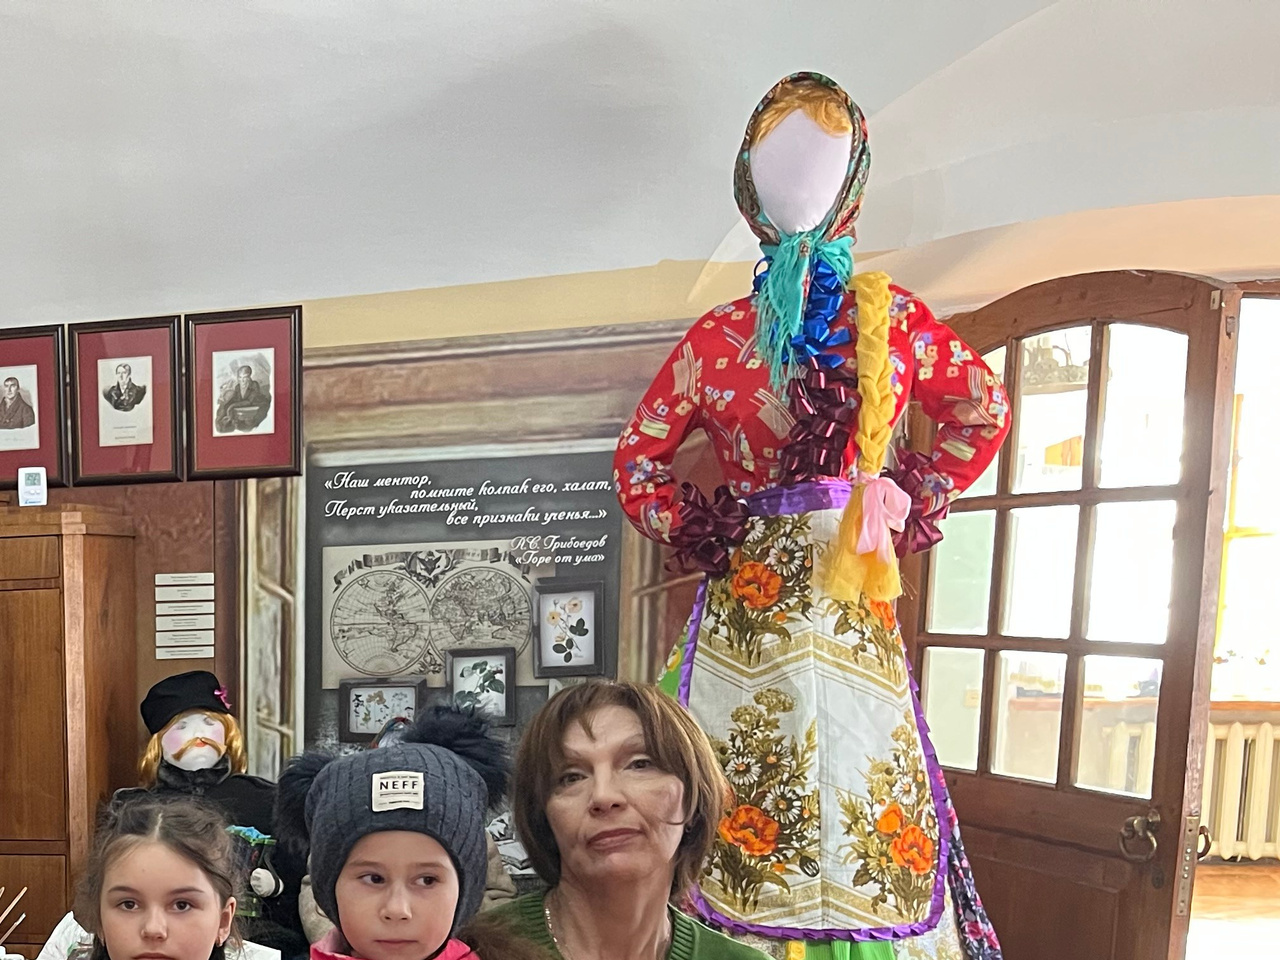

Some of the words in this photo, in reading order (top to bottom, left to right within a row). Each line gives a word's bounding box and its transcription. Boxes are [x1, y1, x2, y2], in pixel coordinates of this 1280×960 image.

[324, 471, 369, 489] «Наш
[373, 475, 432, 488] ментор,
[410, 487, 475, 499] помните
[478, 478, 532, 496] колпак
[532, 483, 557, 494] его,
[562, 480, 612, 492] халат,
[324, 500, 375, 520] Перст
[377, 499, 479, 518] указательный,
[446, 510, 469, 525] все
[472, 506, 540, 528] признаки
[543, 534, 608, 552] Грибоедов
[515, 550, 552, 567] «Горе
[554, 554, 572, 563] от
[574, 553, 605, 566] ума»
[380, 780, 419, 790] NEFF
